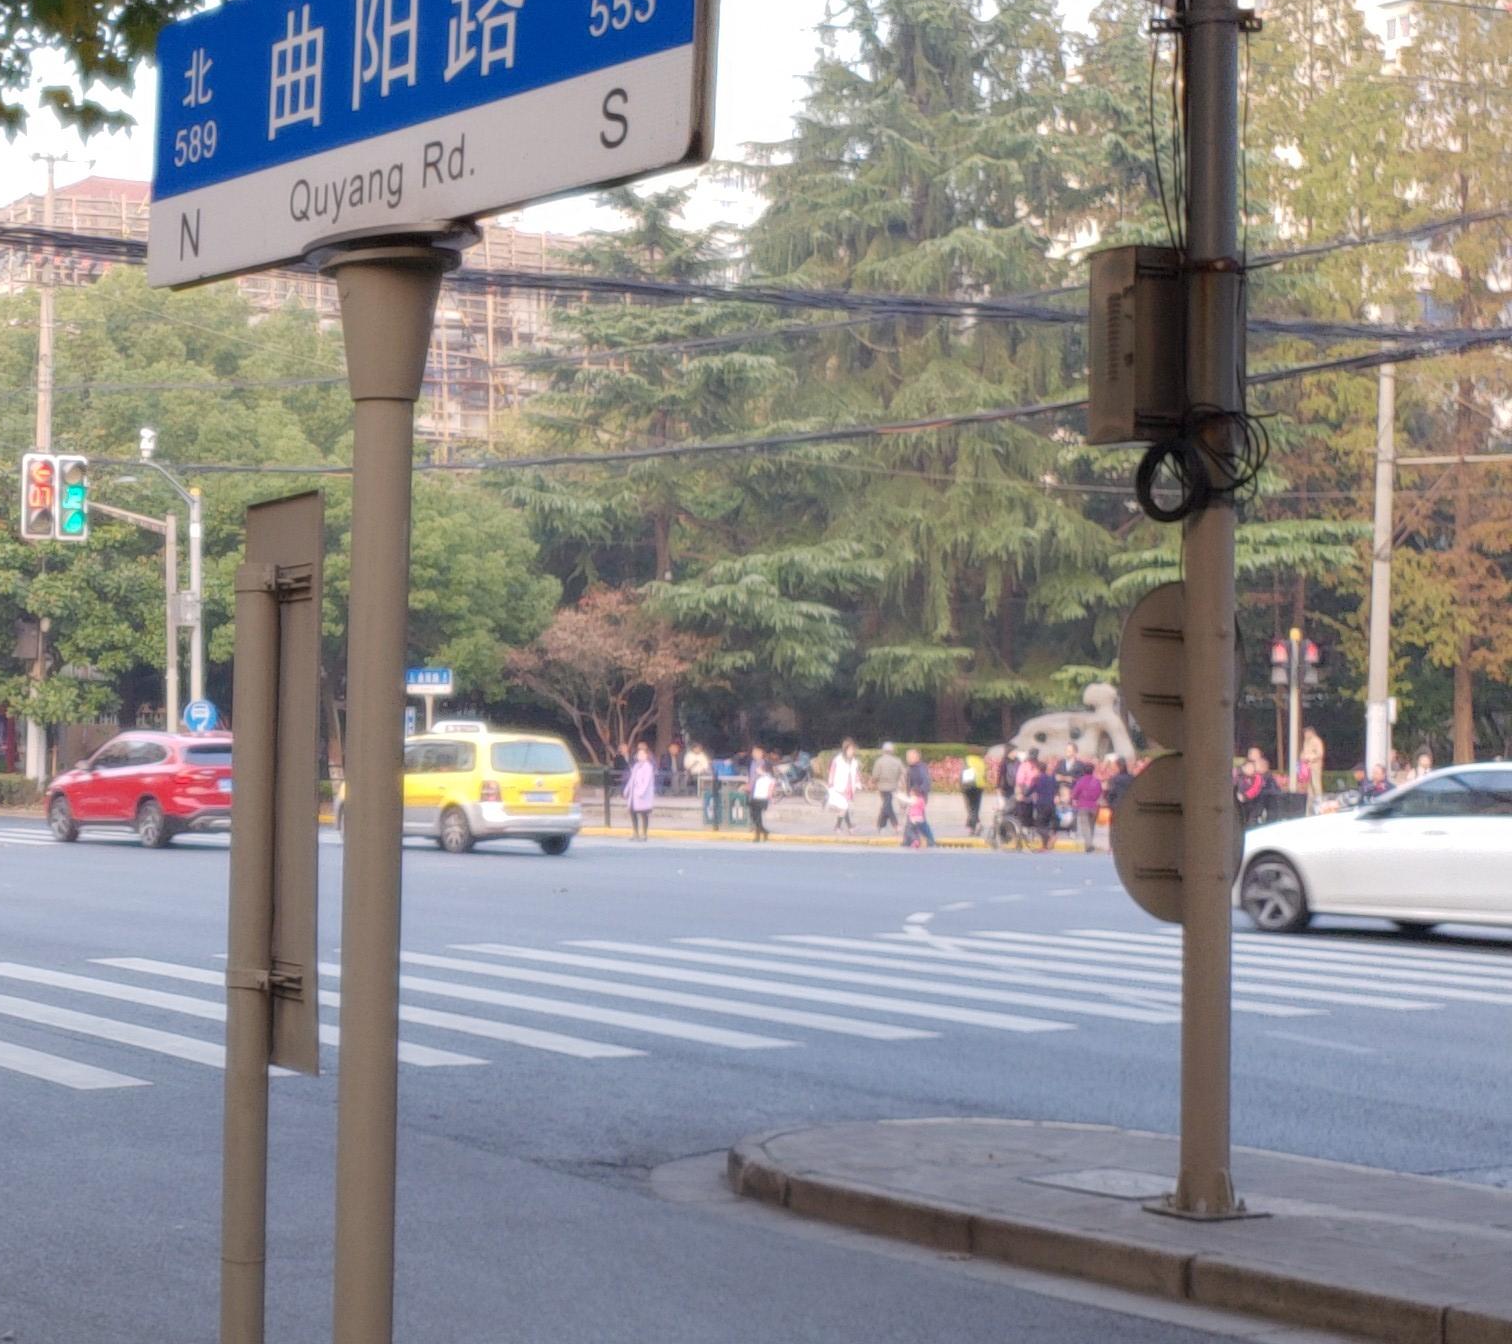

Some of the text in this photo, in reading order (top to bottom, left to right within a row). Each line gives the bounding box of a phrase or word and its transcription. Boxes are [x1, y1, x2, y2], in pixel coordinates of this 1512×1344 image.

[182, 47, 214, 108] 北
[174, 120, 218, 167] 589
[600, 87, 629, 149] S
[289, 133, 475, 224] Quyang Rd.
[180, 208, 201, 261] N
